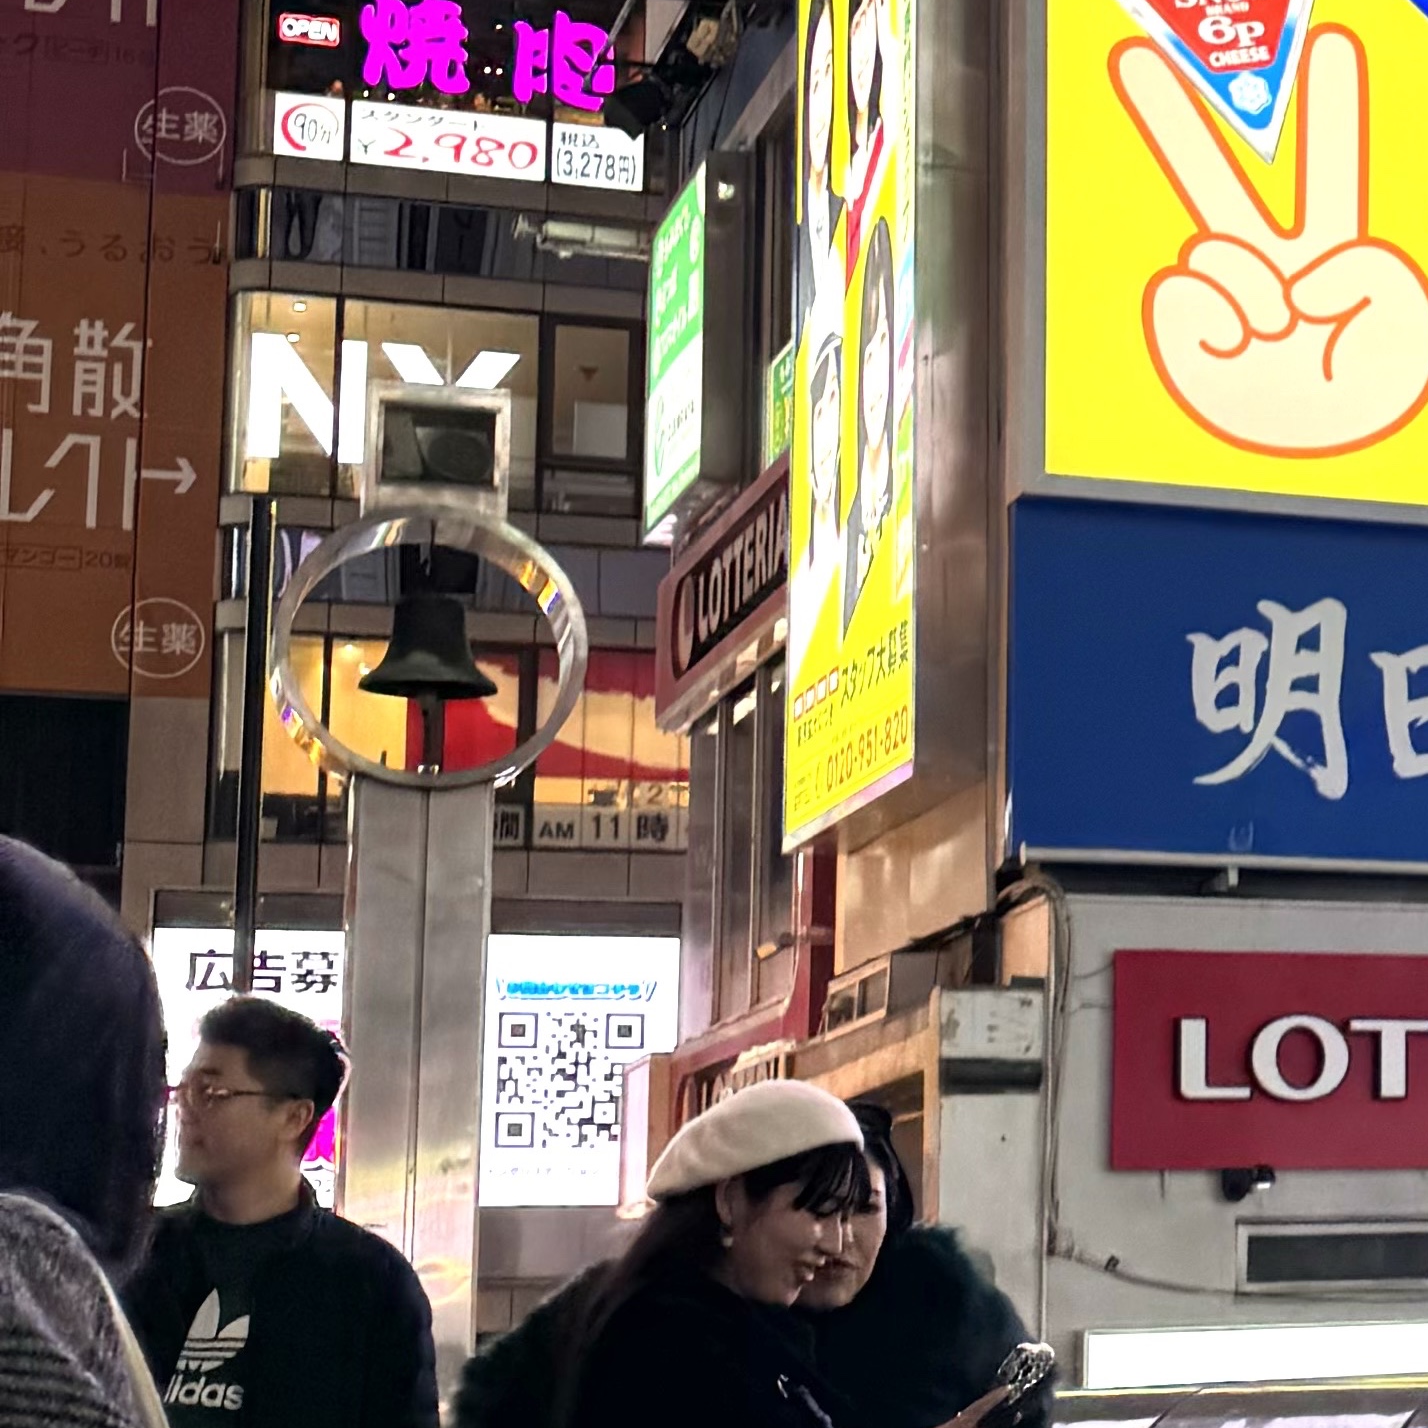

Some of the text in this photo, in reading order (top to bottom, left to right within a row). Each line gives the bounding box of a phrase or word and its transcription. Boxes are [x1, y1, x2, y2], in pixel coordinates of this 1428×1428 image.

[281, 18, 338, 42] OPEN
[1209, 45, 1270, 68] CHEESE
[697, 489, 789, 638] LOTTERIA
[118, 619, 199, 656] 生薬
[539, 821, 575, 840] AM
